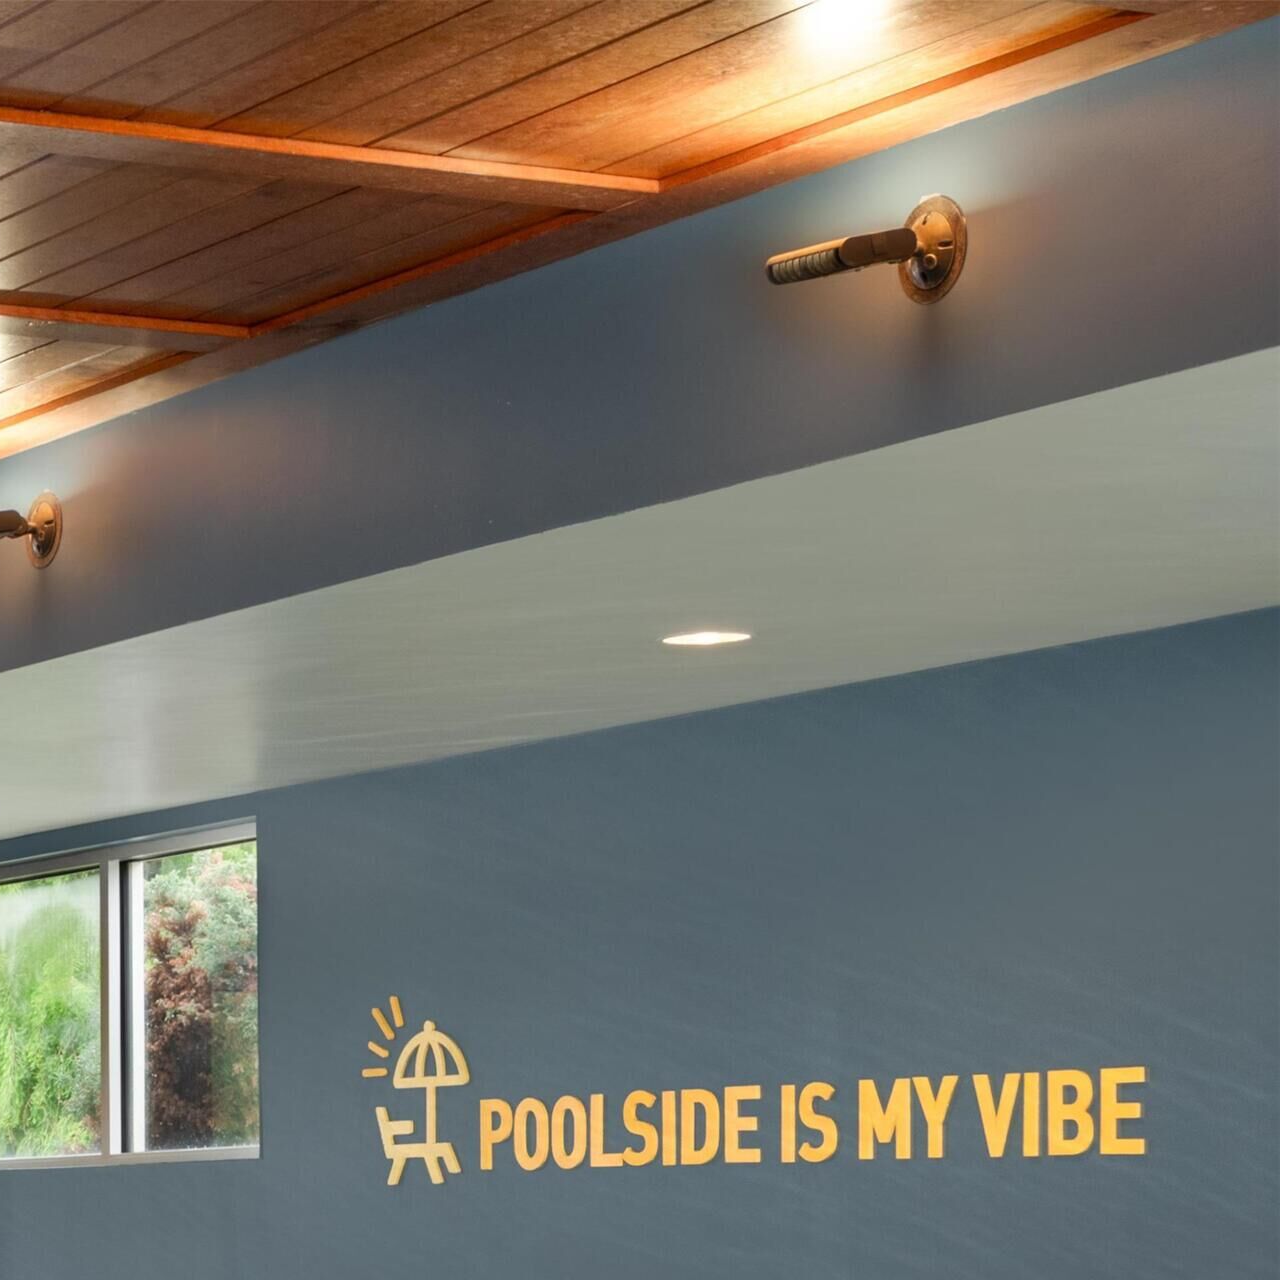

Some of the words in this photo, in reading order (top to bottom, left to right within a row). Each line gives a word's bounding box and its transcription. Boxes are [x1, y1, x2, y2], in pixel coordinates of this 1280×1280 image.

[480, 1085, 762, 1171] POOLSIDE
[781, 1081, 839, 1163] IS
[858, 1074, 959, 1160] MY
[972, 1065, 1147, 1158] VIBE
